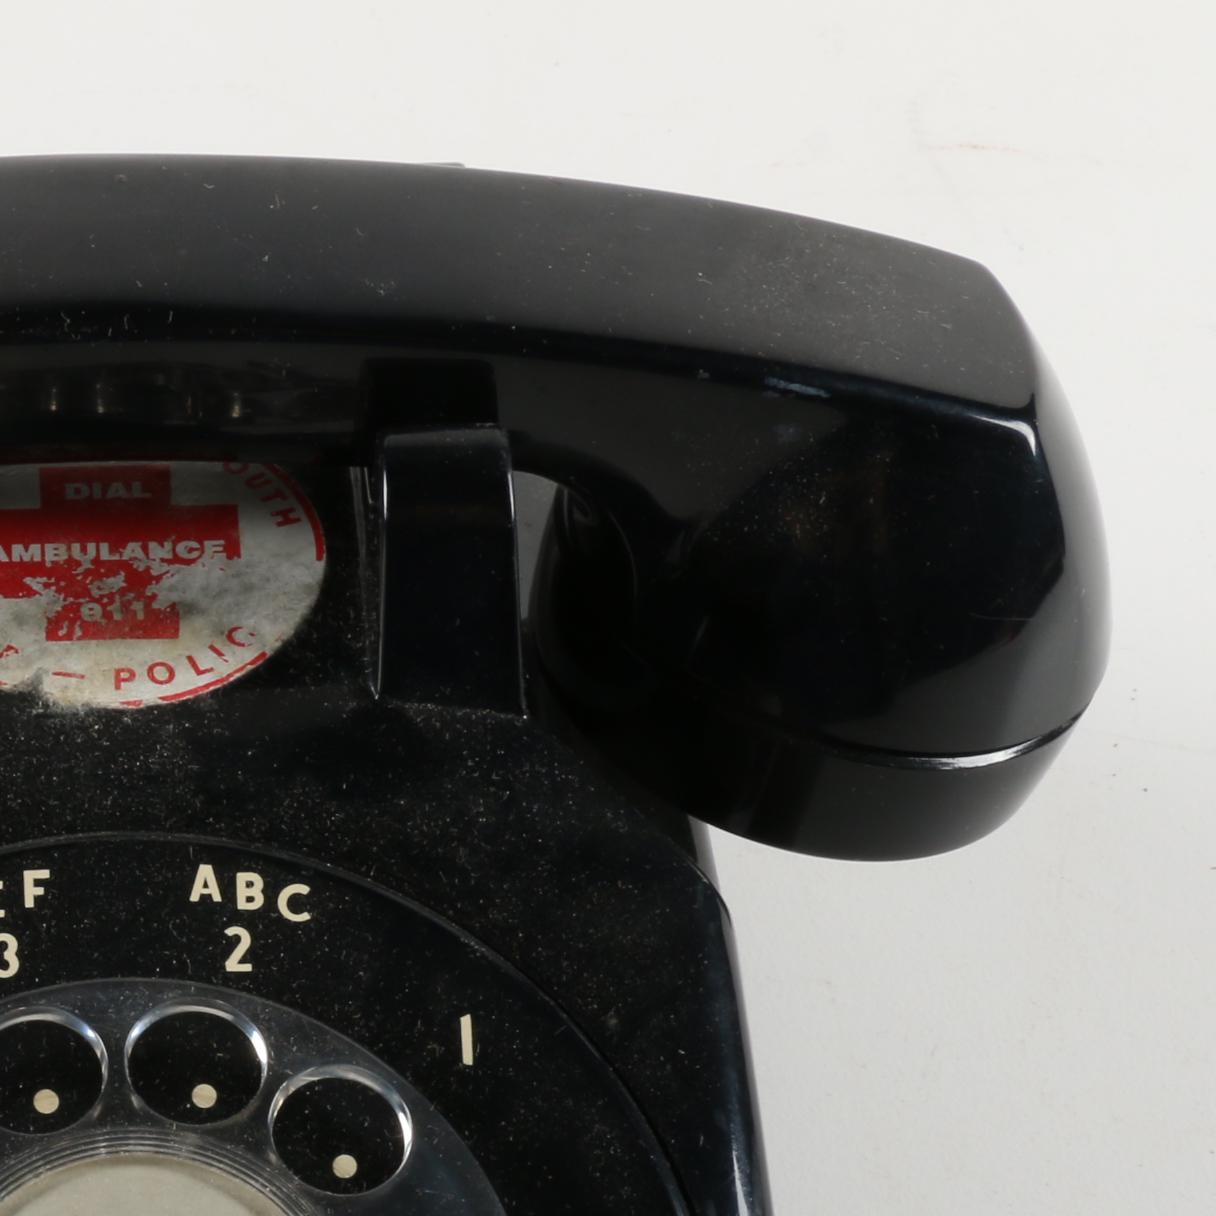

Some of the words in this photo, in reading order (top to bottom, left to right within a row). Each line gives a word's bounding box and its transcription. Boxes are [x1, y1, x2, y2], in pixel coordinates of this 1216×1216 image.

[65, 482, 152, 499] DIAL
[222, 463, 302, 527] OUTH
[114, 625, 257, 690] POLIC
[189, 863, 311, 922] ABC
[224, 926, 253, 972] 2
